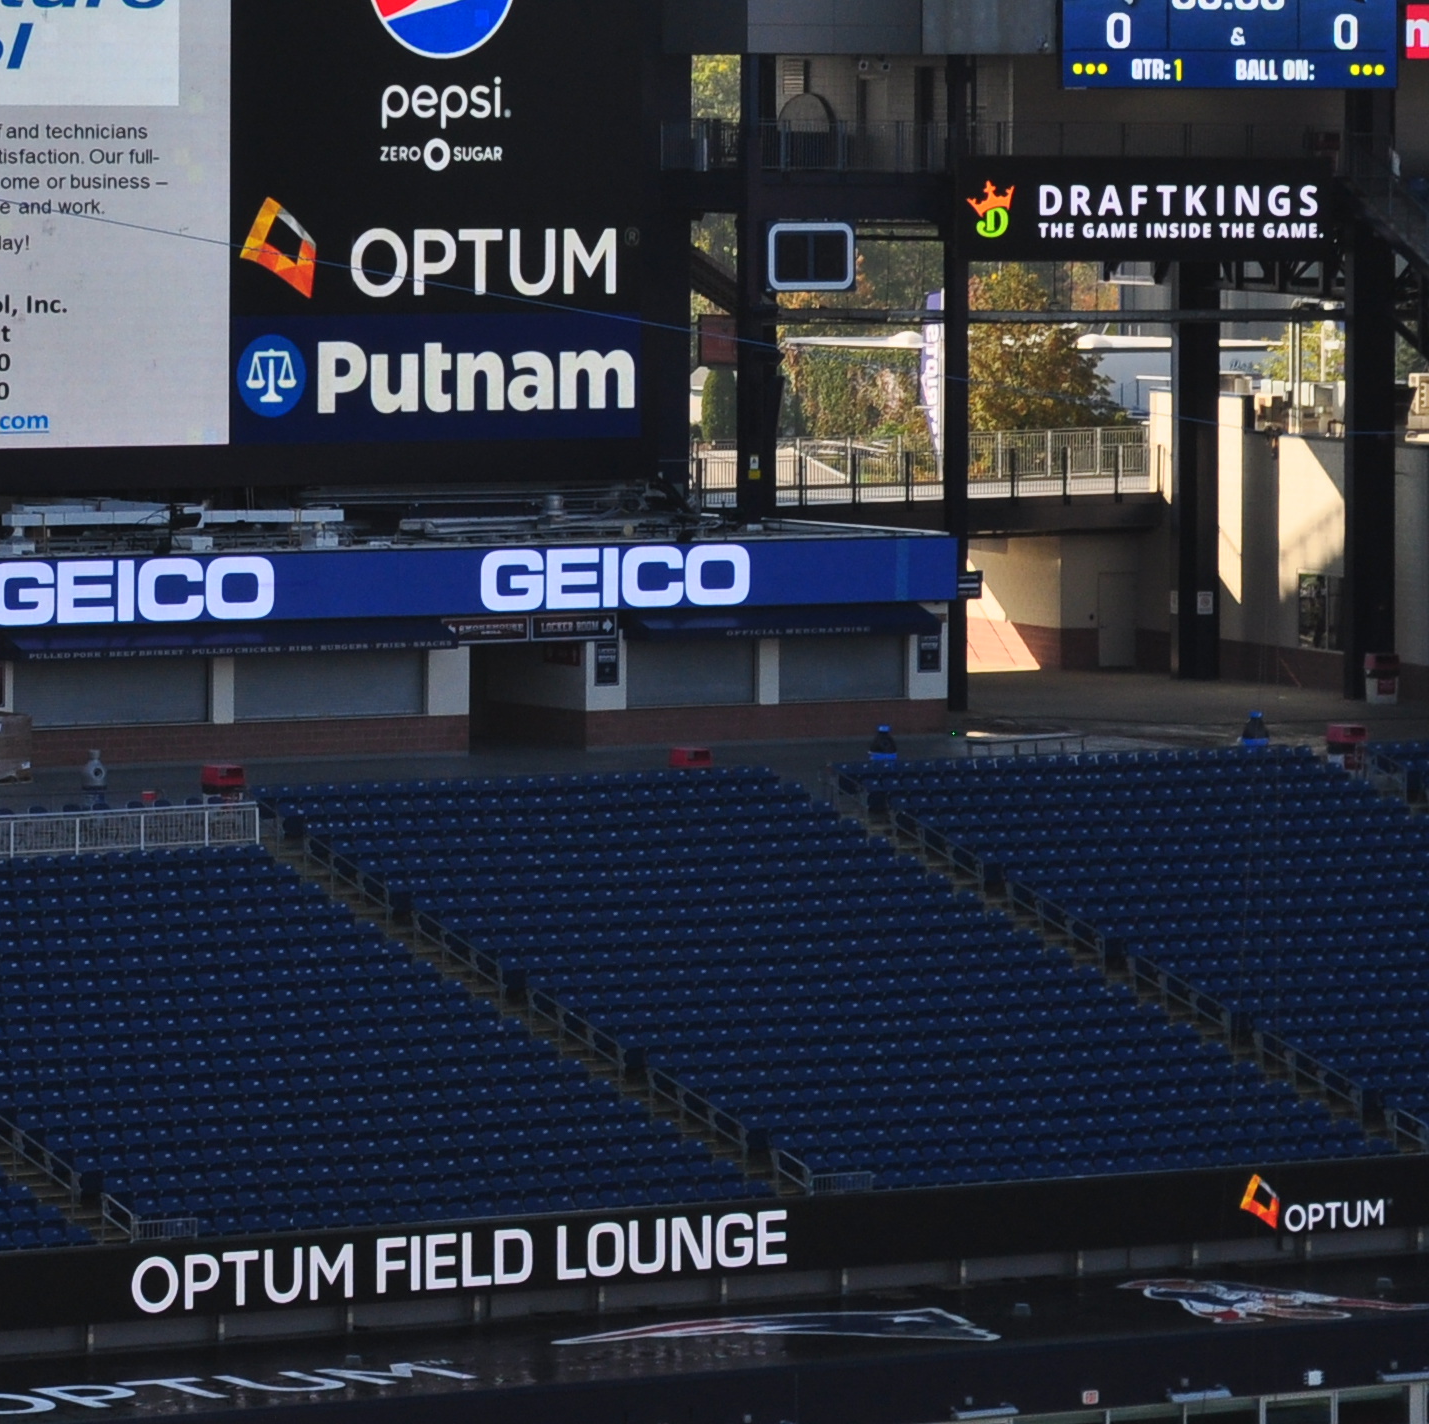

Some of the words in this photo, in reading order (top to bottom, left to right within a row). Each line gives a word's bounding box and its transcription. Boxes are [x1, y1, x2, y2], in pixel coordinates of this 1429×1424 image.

[1107, 12, 1131, 49] 0
[1230, 27, 1246, 45] &
[1334, 13, 1358, 50] 0
[1132, 58, 1171, 81] QTR:
[1174, 58, 1182, 81] 1
[1236, 58, 1280, 81] BALL
[1283, 58, 1315, 81] ON:
[6, 124, 39, 139] and
[46, 125, 148, 139] technicians
[381, 146, 421, 161] ZERO
[453, 146, 502, 161] SUGAR
[1039, 185, 1319, 217] DRAFTKINGS
[1039, 223, 1078, 238] THE
[1083, 223, 1139, 238] GAME
[1146, 223, 1212, 238] INSIDE
[1219, 223, 1256, 238] THE
[1262, 223, 1324, 238] GAME.
[351, 227, 617, 297] OPTUM
[27, 296, 68, 315] Inc.
[317, 341, 635, 413] Putnam
[480, 543, 751, 612] GEICO
[1284, 1198, 1385, 1233] OPTUM
[131, 1243, 354, 1314] OPTUM
[376, 1228, 534, 1294] FIELD
[557, 1210, 788, 1280] LOUNGE
